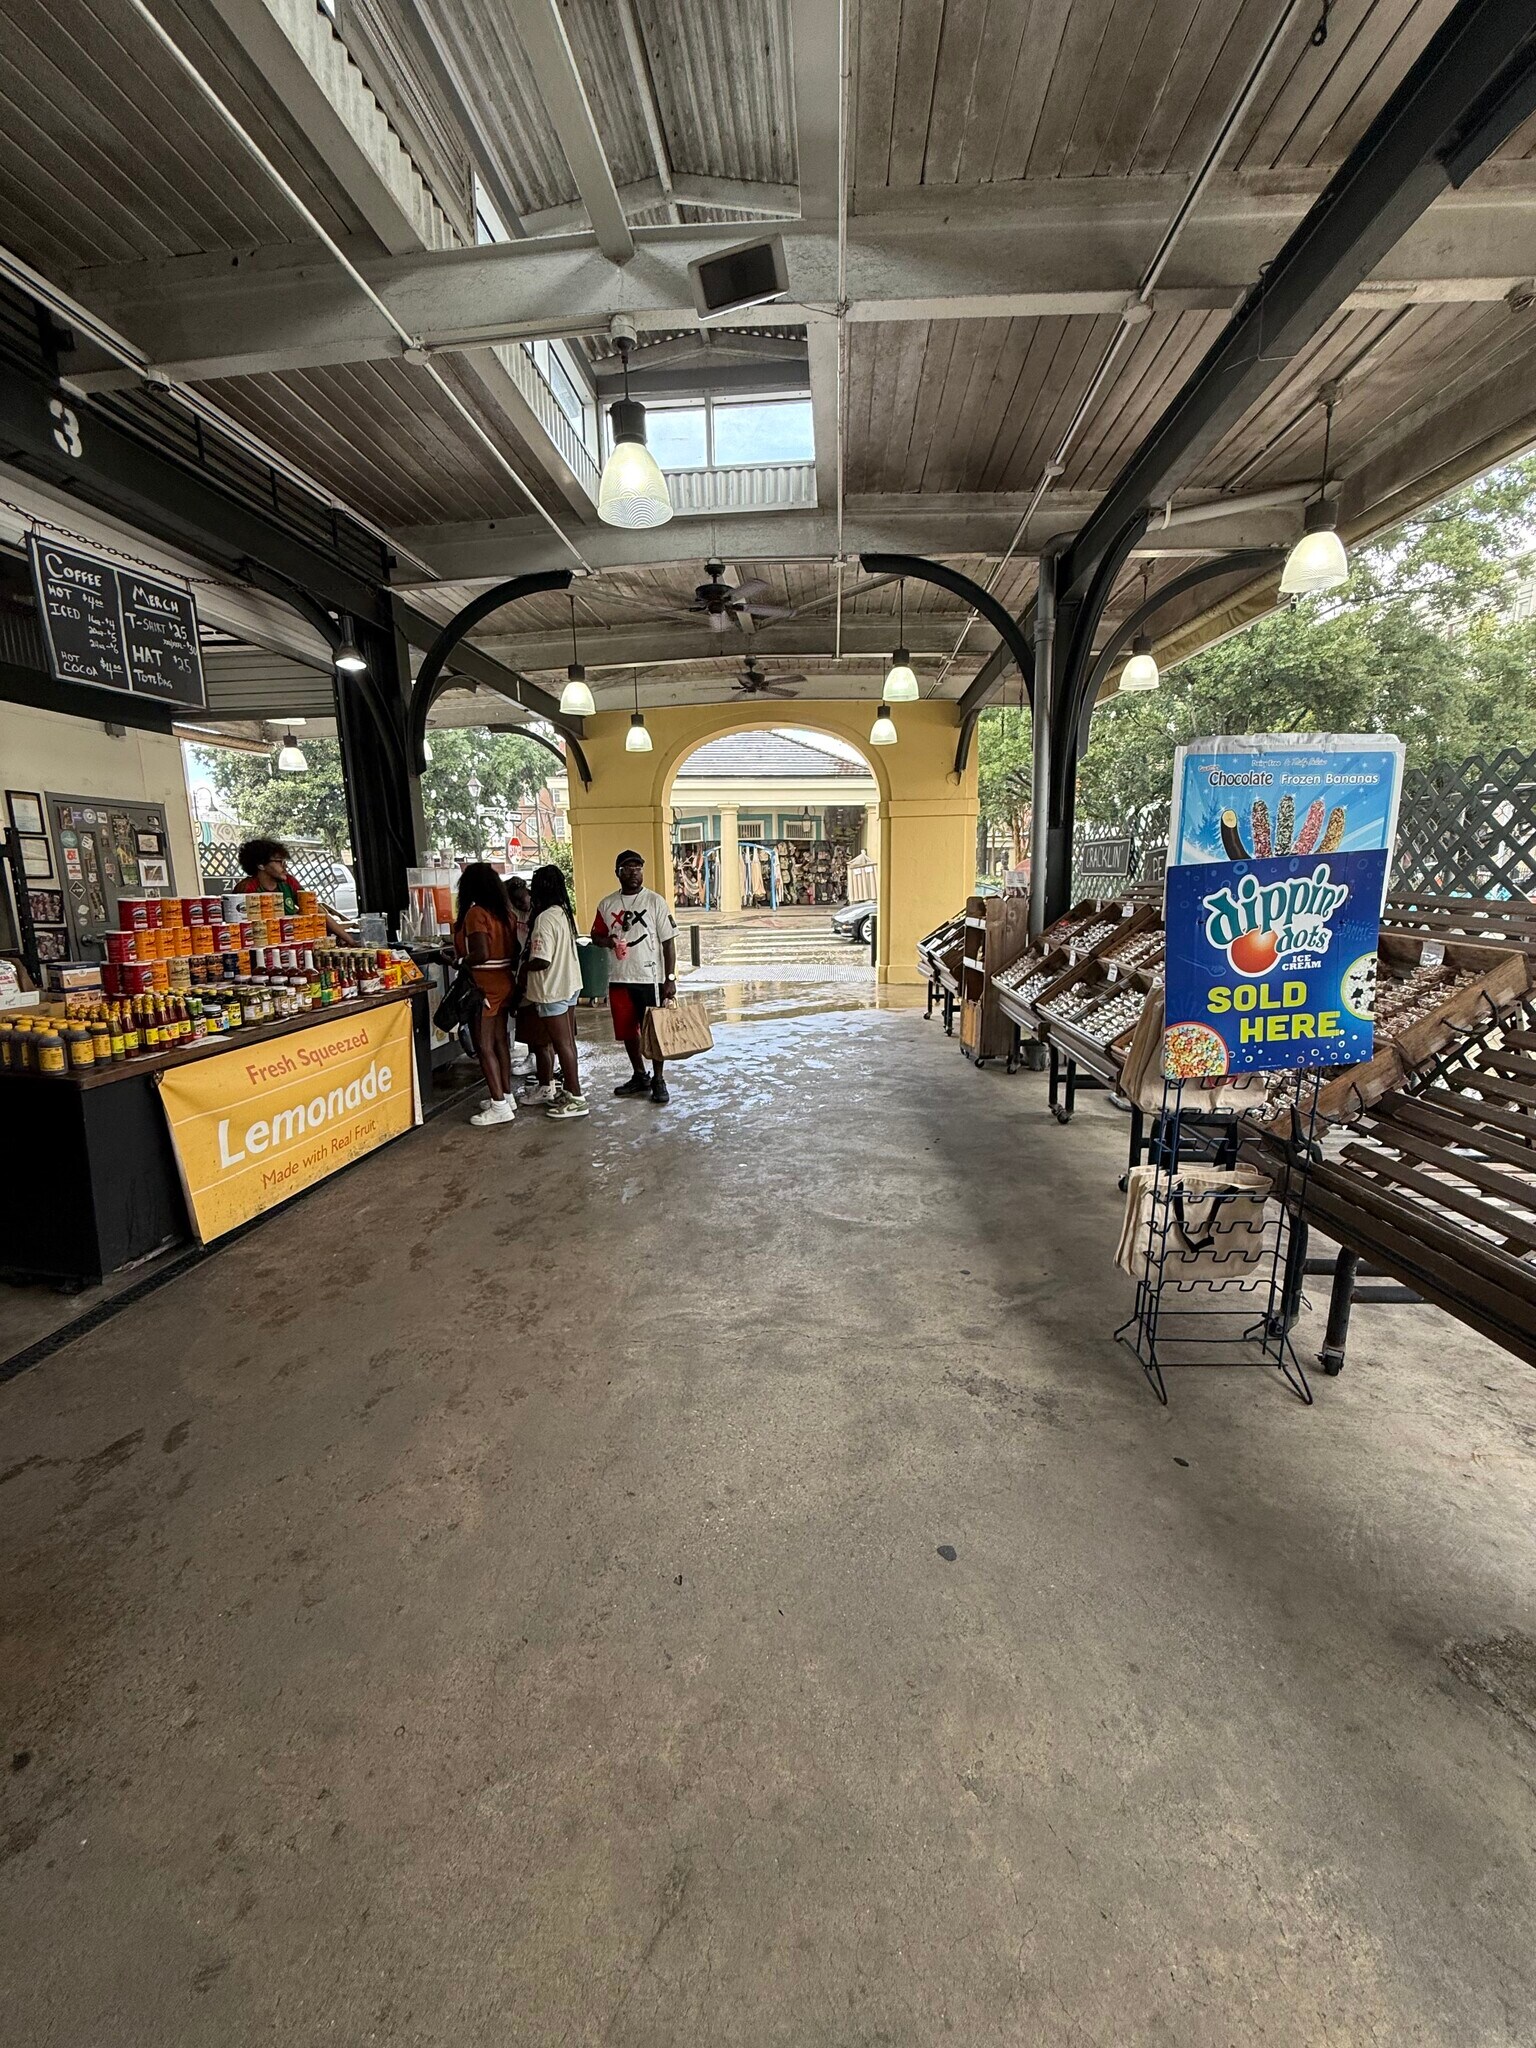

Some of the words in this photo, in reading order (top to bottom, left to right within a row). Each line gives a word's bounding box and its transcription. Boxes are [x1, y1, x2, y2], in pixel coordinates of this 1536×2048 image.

[50, 398, 83, 459] 3
[47, 583, 72, 600] HOT
[132, 584, 179, 613] MERCH
[49, 602, 80, 620] ICED
[124, 612, 166, 634] T-SHIRT
[60, 650, 80, 662] HOT
[132, 645, 163, 667] HAT
[63, 661, 98, 676] COCOA
[1208, 770, 1274, 787] Chocolate
[1280, 774, 1321, 785] Frozen
[1325, 774, 1379, 785] Bananas
[1275, 924, 1328, 953] dots
[1281, 960, 1322, 971] CREAM
[1292, 954, 1312, 963] ICE
[1206, 981, 1308, 1014] SOLD
[245, 1054, 298, 1086] Fresh
[296, 1028, 370, 1066] Squeezed
[217, 1059, 394, 1170] Lemonade
[261, 1166, 300, 1190] Made
[302, 1144, 328, 1169] with
[330, 1134, 353, 1152] Real
[354, 1118, 377, 1140] Fruit
